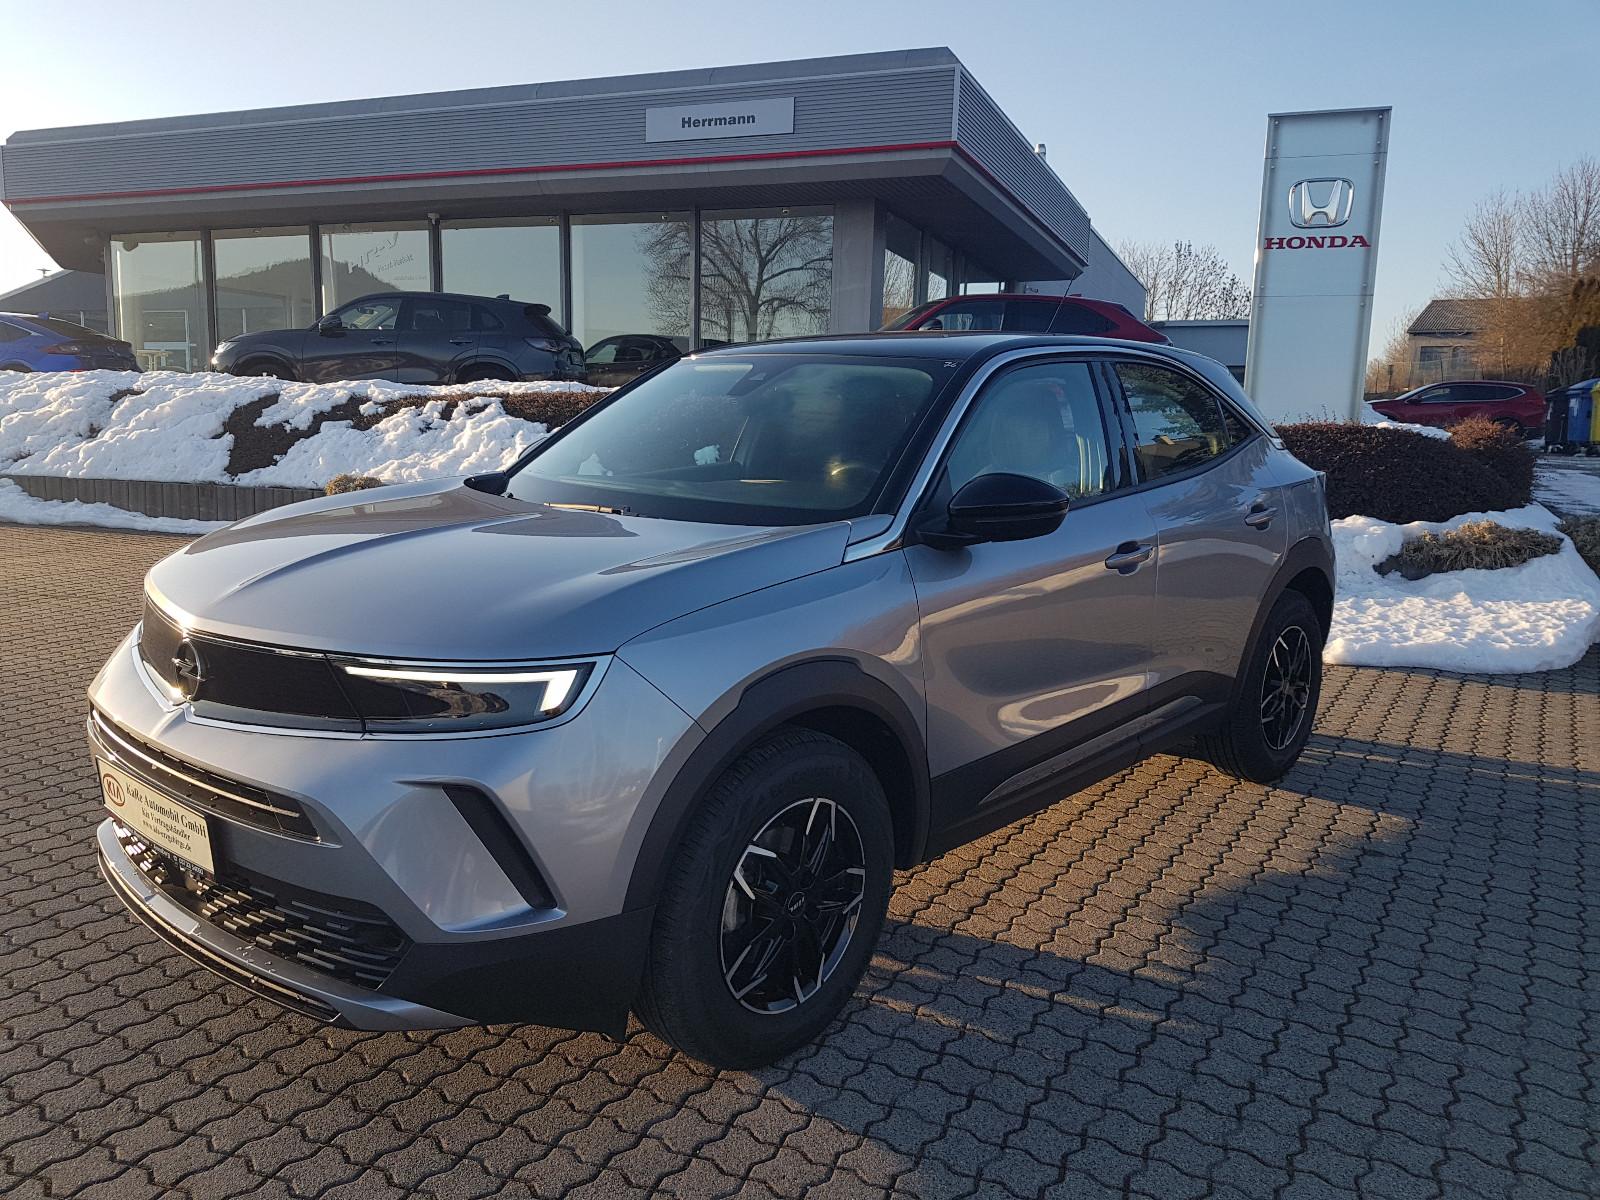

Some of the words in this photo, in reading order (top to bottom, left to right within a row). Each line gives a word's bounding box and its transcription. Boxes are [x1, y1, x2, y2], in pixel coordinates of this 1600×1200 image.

[681, 114, 756, 128] Herrmann
[1264, 235, 1371, 249] HONDA
[144, 795, 180, 823] Automobil
[181, 814, 207, 838] GmbH
